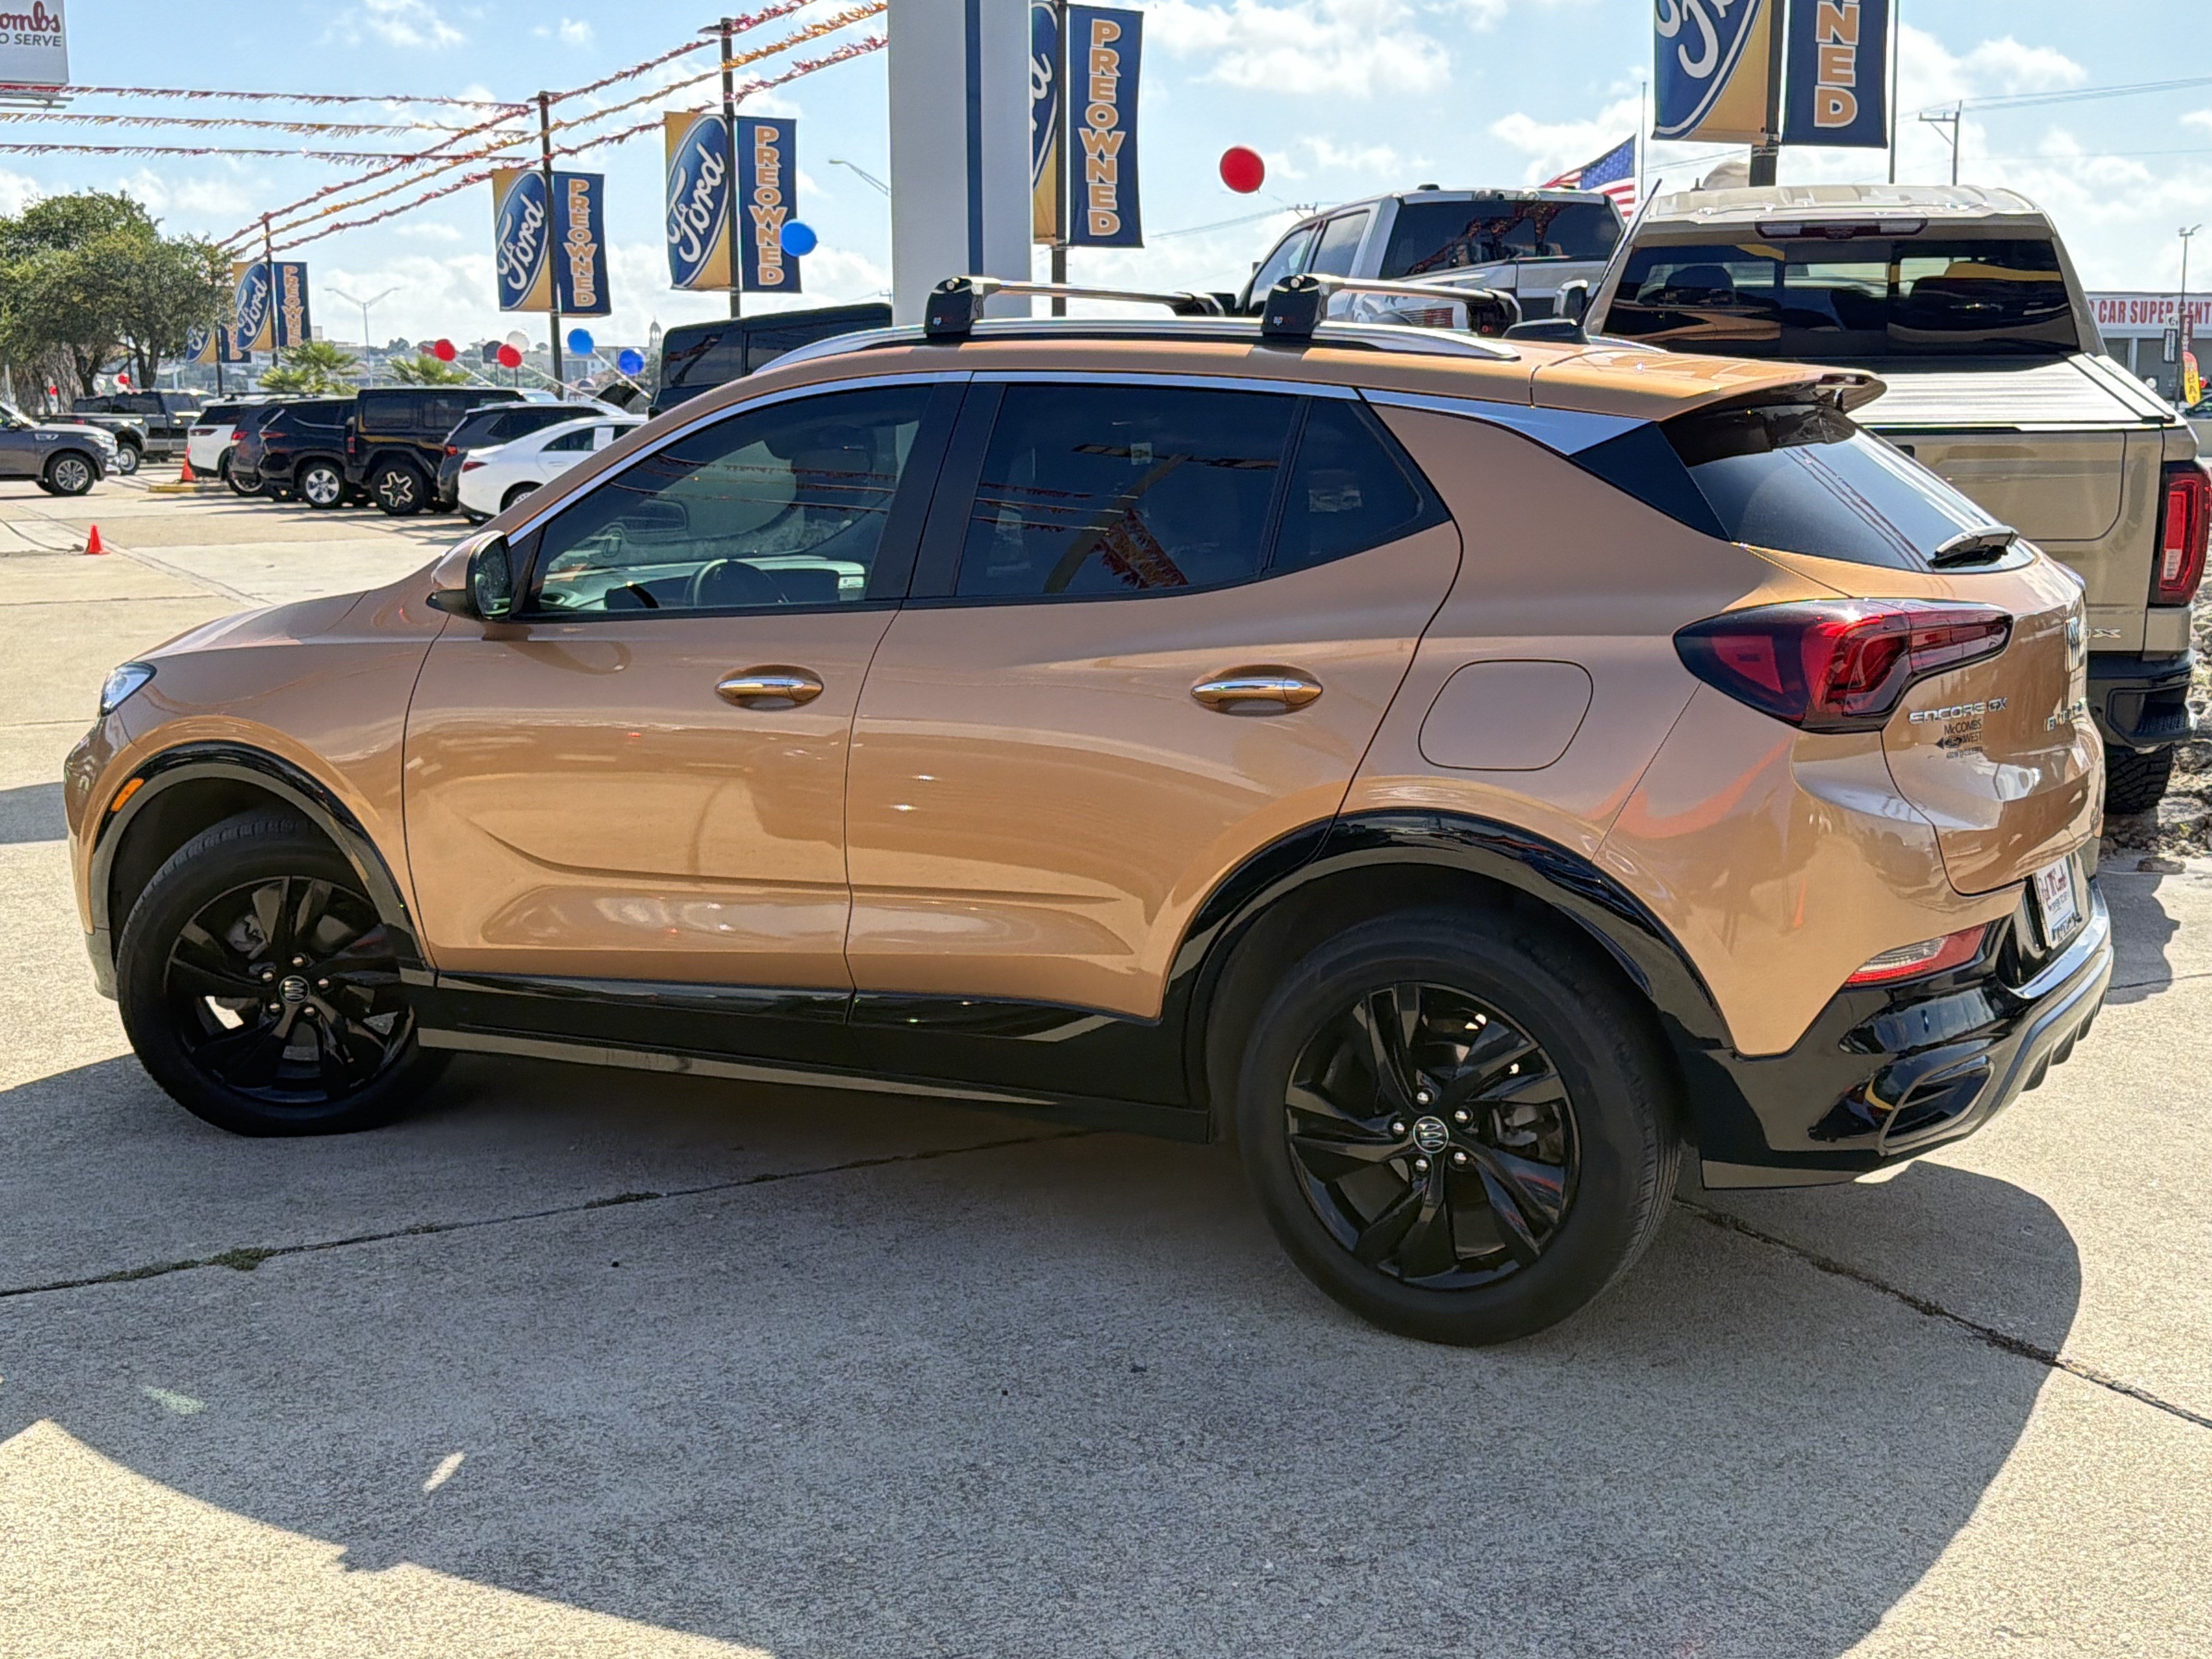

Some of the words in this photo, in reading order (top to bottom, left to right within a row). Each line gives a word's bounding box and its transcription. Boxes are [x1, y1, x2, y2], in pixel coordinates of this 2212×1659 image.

[14, 33, 61, 47] SERVE
[1813, 0, 1860, 127] NED
[1078, 18, 1126, 236] PREOWNED
[496, 193, 544, 290] Ford
[563, 178, 597, 307] PREOWNED
[667, 142, 725, 263] Ford
[748, 125, 788, 285] PREOWNED
[237, 275, 268, 337] Ford
[2098, 300, 2126, 324] CAR
[2177, 301, 2212, 324] CENT
[1909, 701, 1985, 724] ENCORE
[1987, 697, 2008, 712] GX
[1944, 718, 1982, 736] McCOMBS
